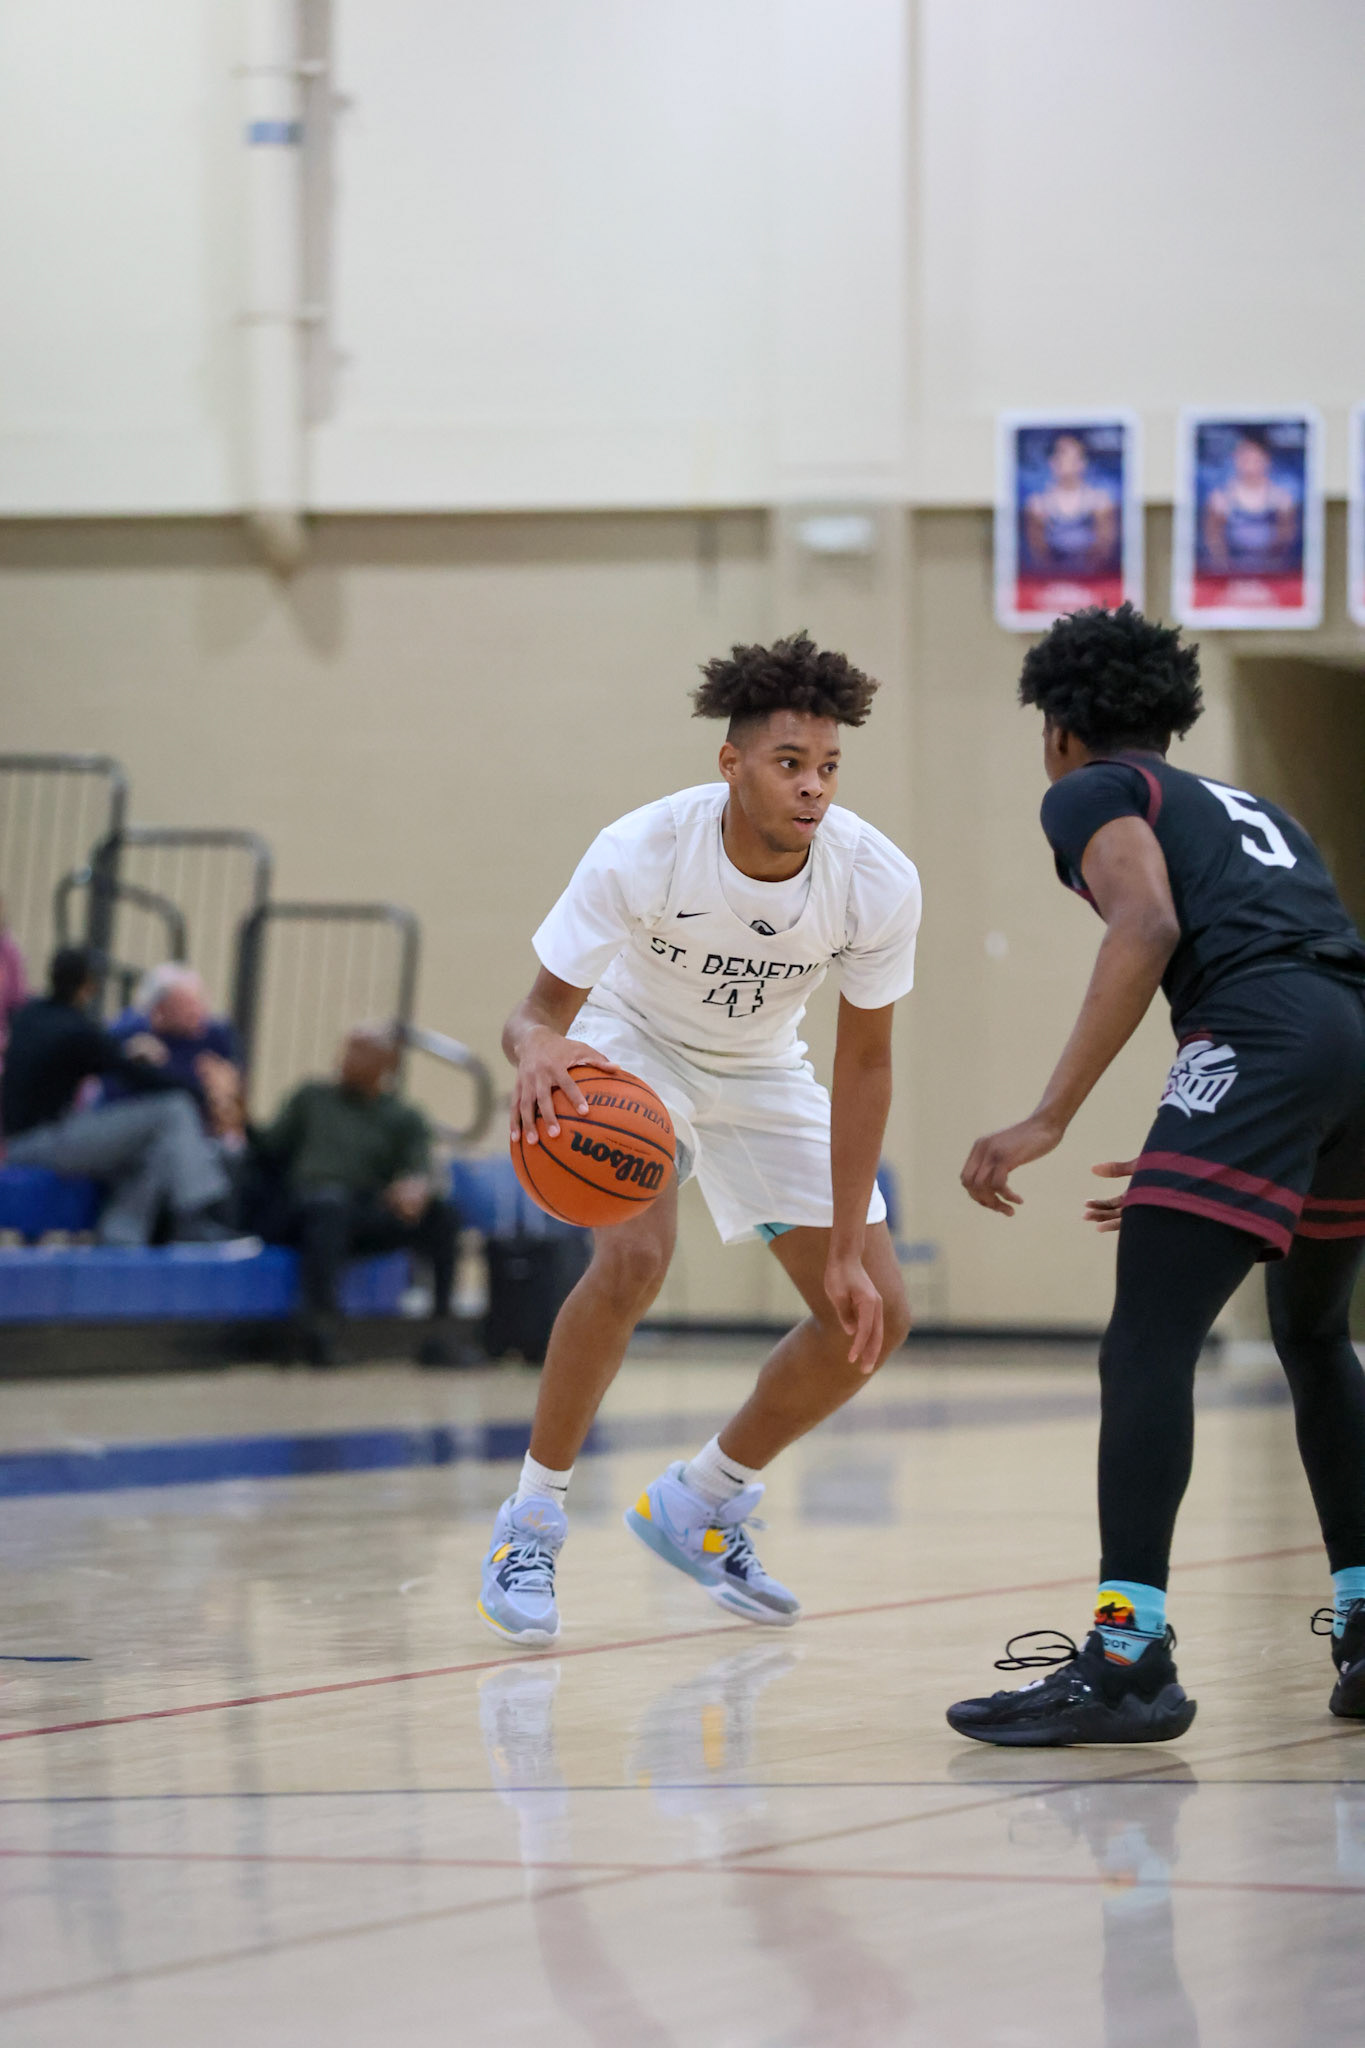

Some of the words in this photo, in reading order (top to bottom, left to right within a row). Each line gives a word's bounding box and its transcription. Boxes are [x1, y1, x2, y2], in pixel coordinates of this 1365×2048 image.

[1199, 777, 1298, 869] 5
[650, 937, 688, 969] ST.
[701, 953, 819, 979] BENEDI
[570, 1130, 665, 1191] Wilson
